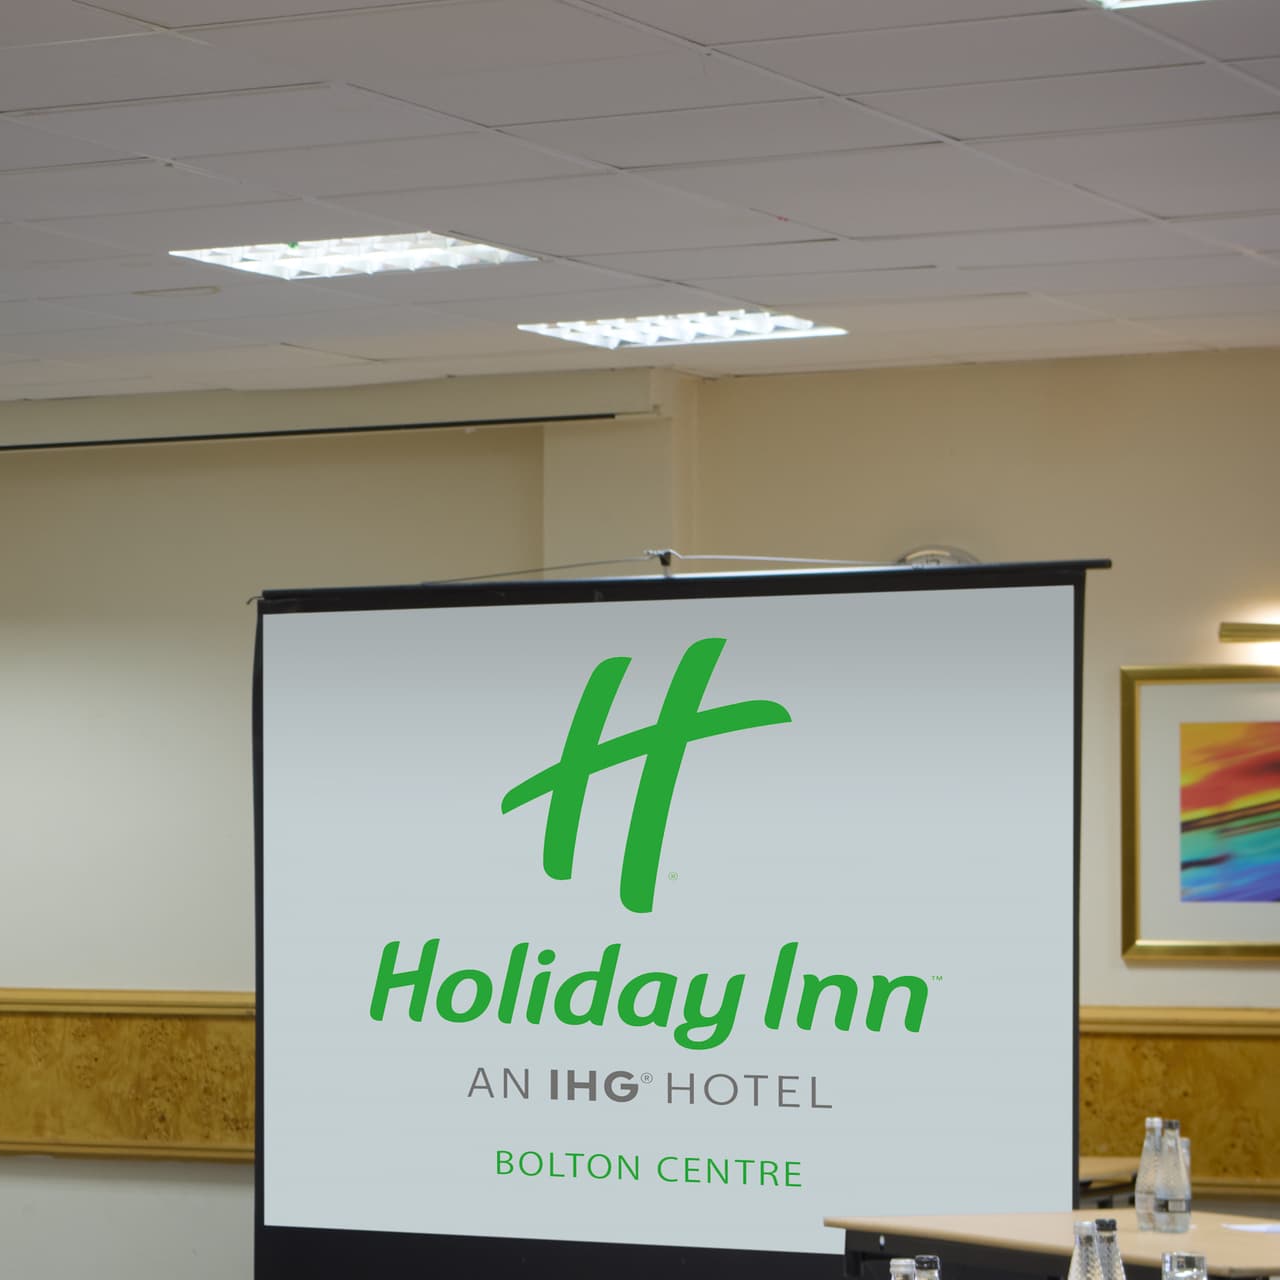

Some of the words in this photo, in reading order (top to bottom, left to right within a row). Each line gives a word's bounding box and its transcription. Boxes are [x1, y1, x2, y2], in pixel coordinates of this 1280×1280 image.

[370, 937, 746, 1051] Holiday
[468, 1067, 529, 1100] AN
[667, 1072, 833, 1109] HOTEL
[495, 1150, 640, 1182] BOLTON
[656, 1155, 802, 1188] CENTRE
